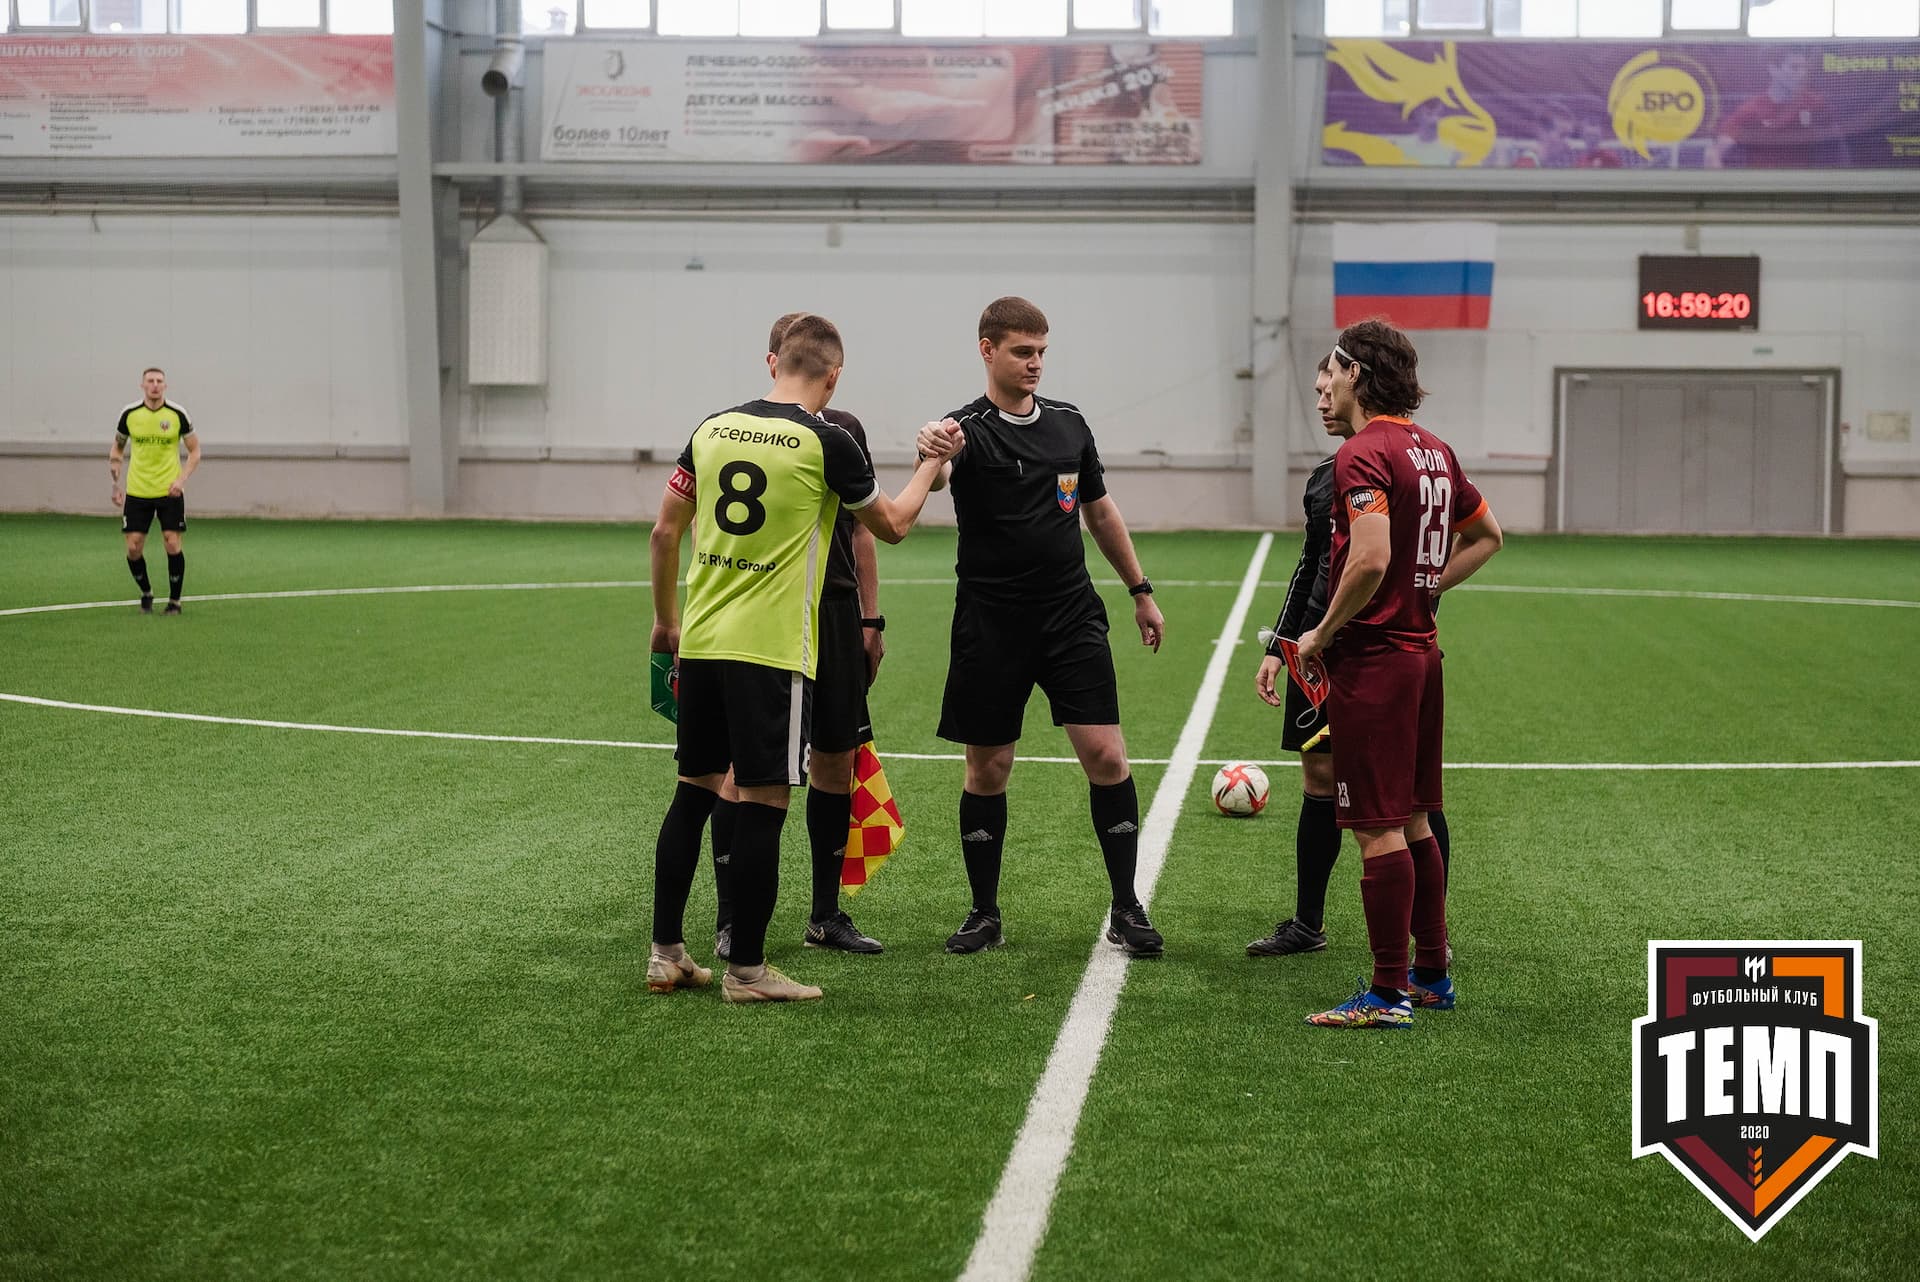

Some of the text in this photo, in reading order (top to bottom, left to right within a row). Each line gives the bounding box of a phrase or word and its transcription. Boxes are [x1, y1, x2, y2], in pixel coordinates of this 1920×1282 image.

[685, 91, 760, 108] ДЕТСКИЙ
[553, 124, 611, 141] более
[1643, 291, 1750, 319] 16:59:20
[714, 460, 768, 536] 8
[1351, 492, 1373, 507] ТЕМП
[1416, 475, 1452, 568] 23
